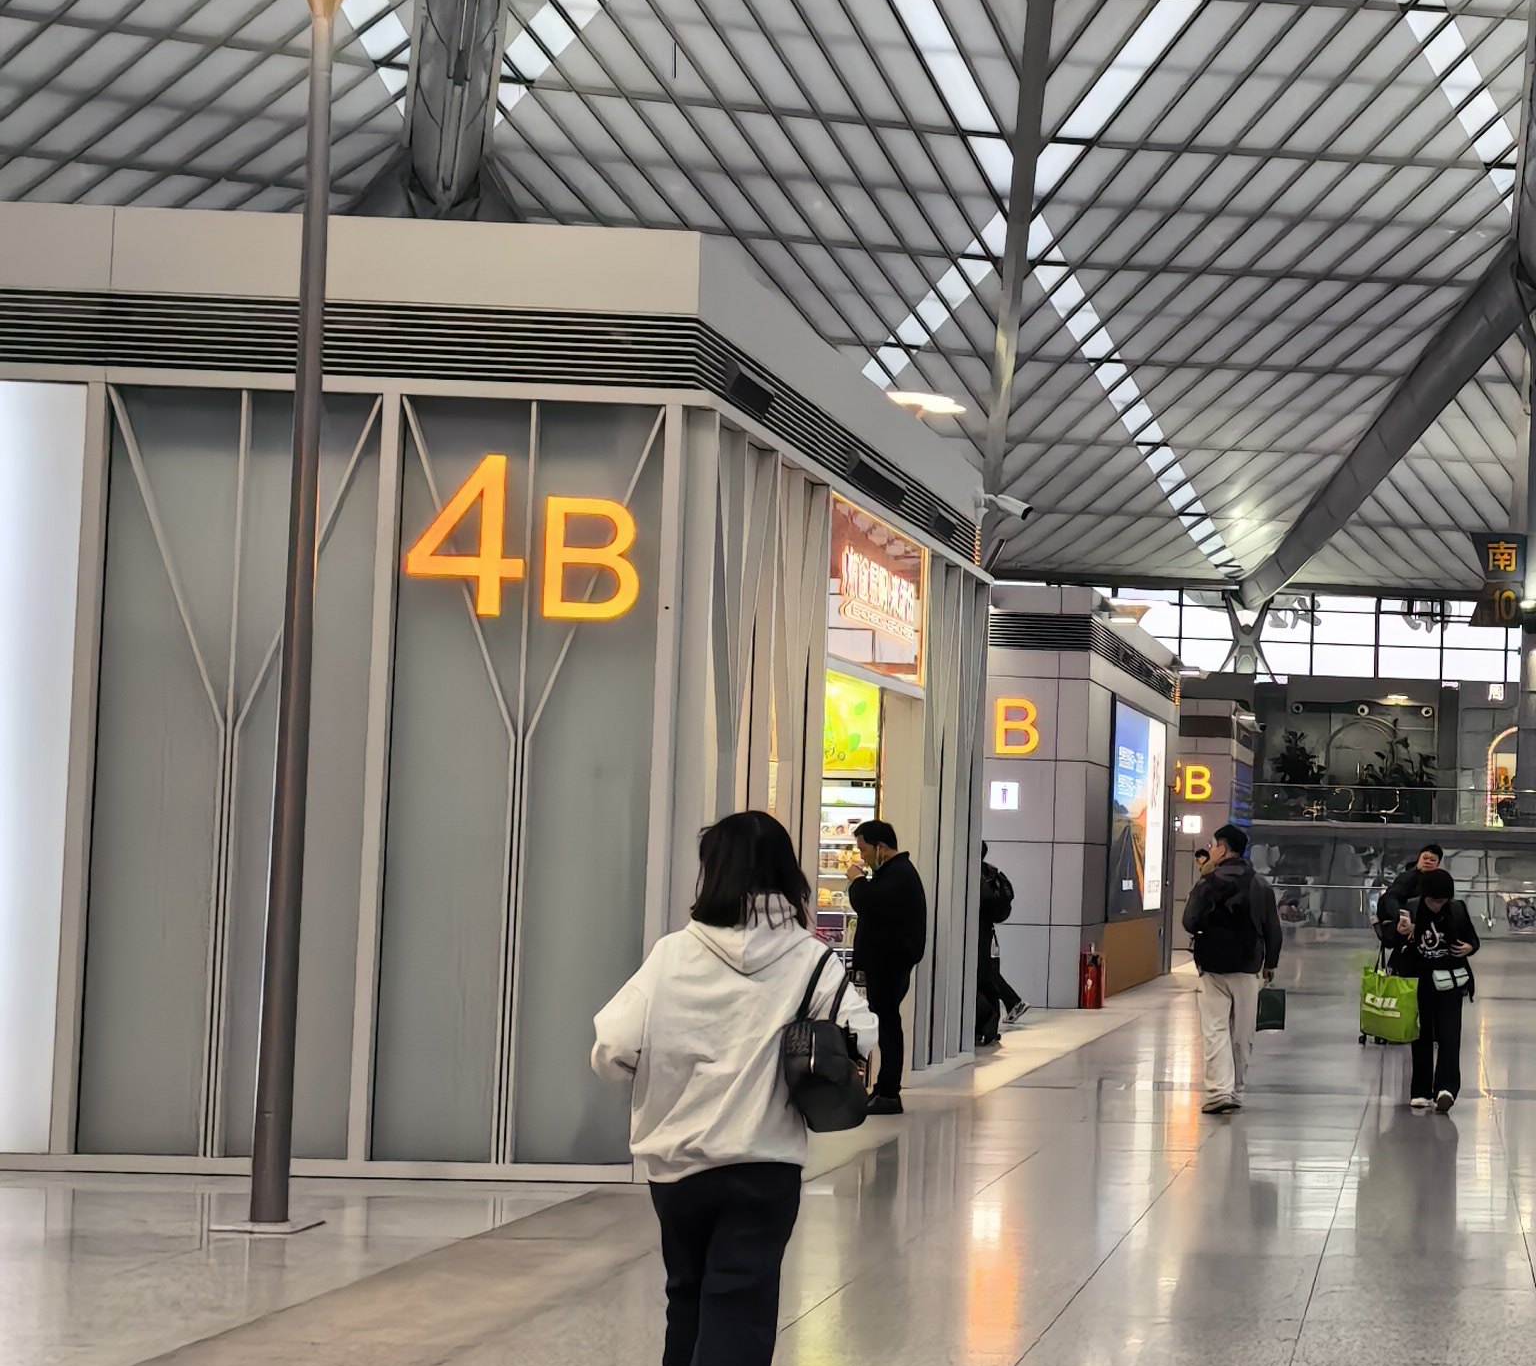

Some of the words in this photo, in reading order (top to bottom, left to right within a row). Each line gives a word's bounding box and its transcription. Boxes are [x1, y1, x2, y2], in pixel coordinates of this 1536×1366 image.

[404, 454, 640, 620] 4B
[1487, 541, 1518, 572] 南
[1493, 590, 1517, 621] 10
[1174, 761, 1212, 801] B
